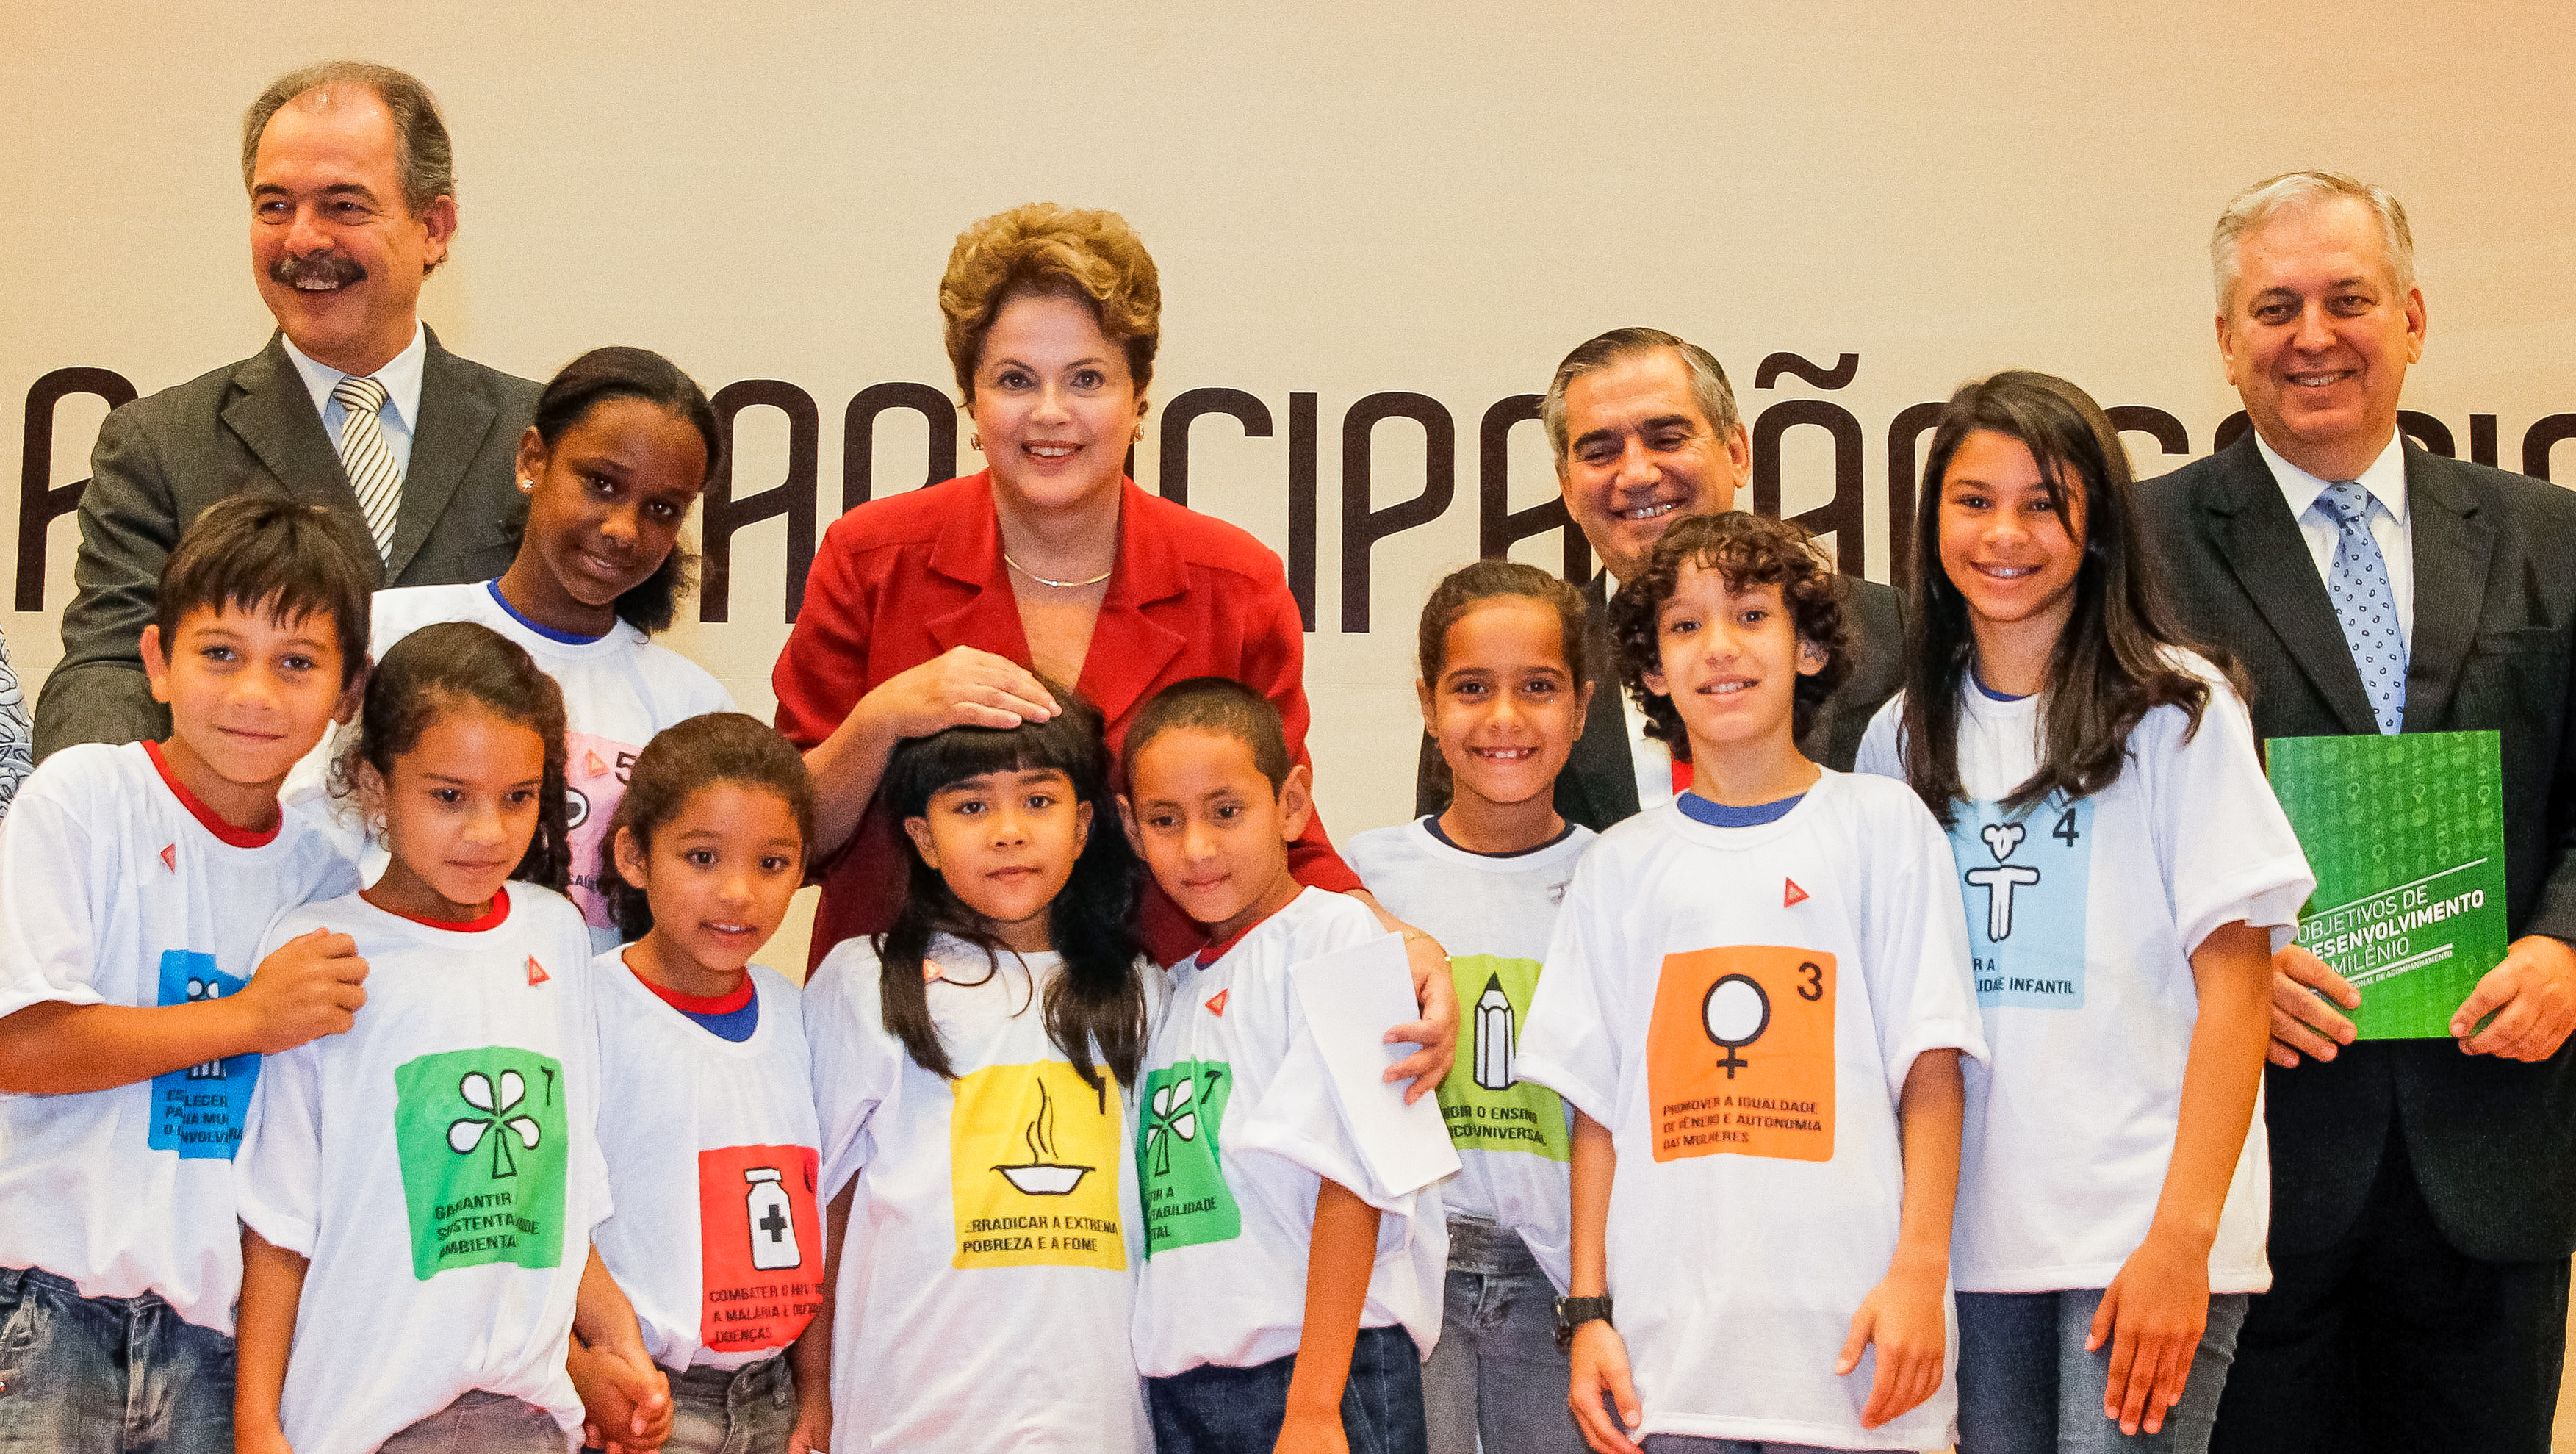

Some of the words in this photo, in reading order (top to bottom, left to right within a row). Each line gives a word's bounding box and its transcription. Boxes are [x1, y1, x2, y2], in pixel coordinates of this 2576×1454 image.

[2052, 807, 2079, 846] 4
[2298, 896, 2397, 943] OBJETIVOS
[2403, 885, 2428, 910] DE
[2305, 889, 2485, 960] ESENVOLVIMENTO
[1987, 958, 1996, 971] A
[2331, 937, 2410, 976] MILÊNIO
[1797, 961, 1824, 1001] 3
[2010, 976, 2075, 994] INFANTIL
[541, 1065, 555, 1106] 7
[1201, 1070, 1223, 1106] 7
[1477, 1106, 1486, 1118] O
[1663, 1097, 1720, 1116] PROMOVER
[1724, 1096, 1733, 1106] A
[1738, 1097, 1818, 1114] IGUALDADE
[1736, 1113, 1822, 1132] AUTONOMIA
[1166, 1187, 1174, 1198] A
[1053, 1215, 1061, 1228] A
[1065, 1217, 1119, 1234] EXTREMA
[439, 1235, 517, 1261] AMBIENTA
[963, 1237, 1033, 1253] POBREZA
[1038, 1236, 1046, 1249] E
[1051, 1237, 1059, 1249] A
[1063, 1237, 1098, 1252] FOME
